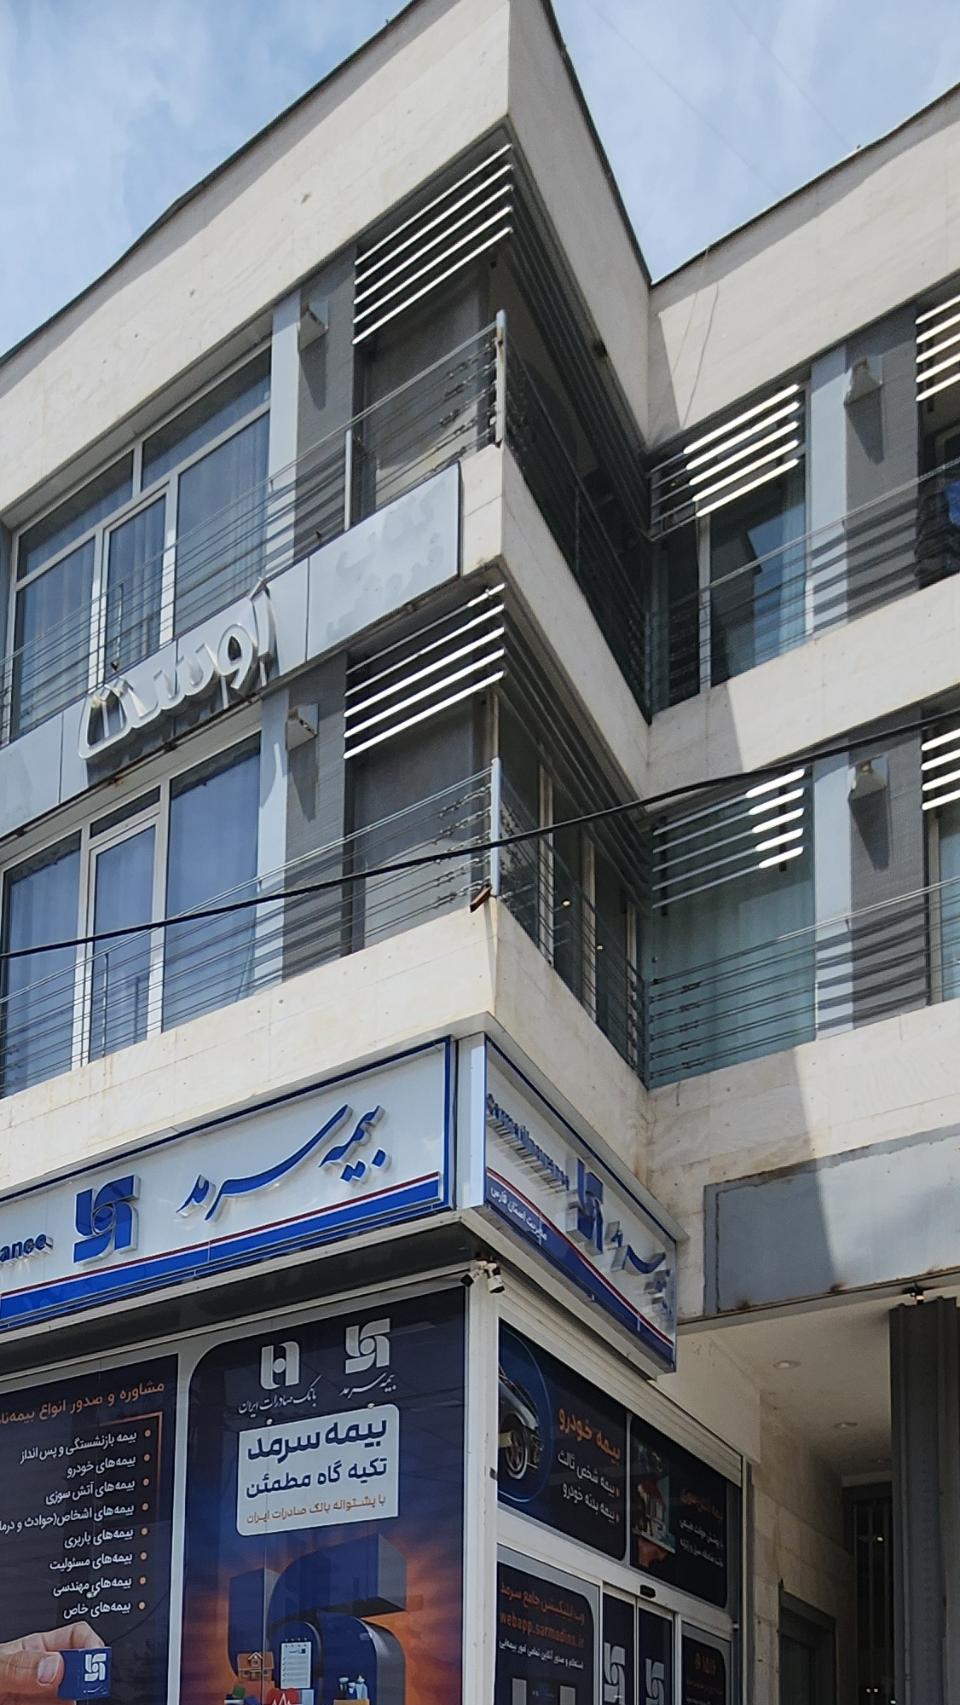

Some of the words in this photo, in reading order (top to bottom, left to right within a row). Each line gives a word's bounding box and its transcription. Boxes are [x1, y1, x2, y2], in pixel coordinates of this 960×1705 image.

[318, 1104, 387, 1184] بیمه
[176, 1103, 352, 1223] سرمد
[107, 1392, 115, 1406] و
[119, 1380, 165, 1401] مشاوره
[39, 1399, 66, 1420] انواع
[70, 1395, 103, 1414] صدور
[116, 1430, 137, 1443] بیمه
[325, 1419, 388, 1448] بیمه
[65, 1434, 116, 1456] بازنشستگی
[247, 1431, 321, 1464] سرمد
[66, 1461, 94, 1479] خودرو
[317, 1459, 343, 1486] گاه
[348, 1457, 388, 1485] تکیه
[246, 1471, 312, 1499] مطمئن
[246, 1510, 270, 1524] ایران
[272, 1507, 307, 1521] صادرات
[309, 1502, 331, 1515] بانک
[64, 1532, 91, 1549] باربری
[49, 1557, 90, 1573] مسئولیت
[52, 1580, 89, 1597] مهندسی
[63, 1603, 89, 1619] خاص
